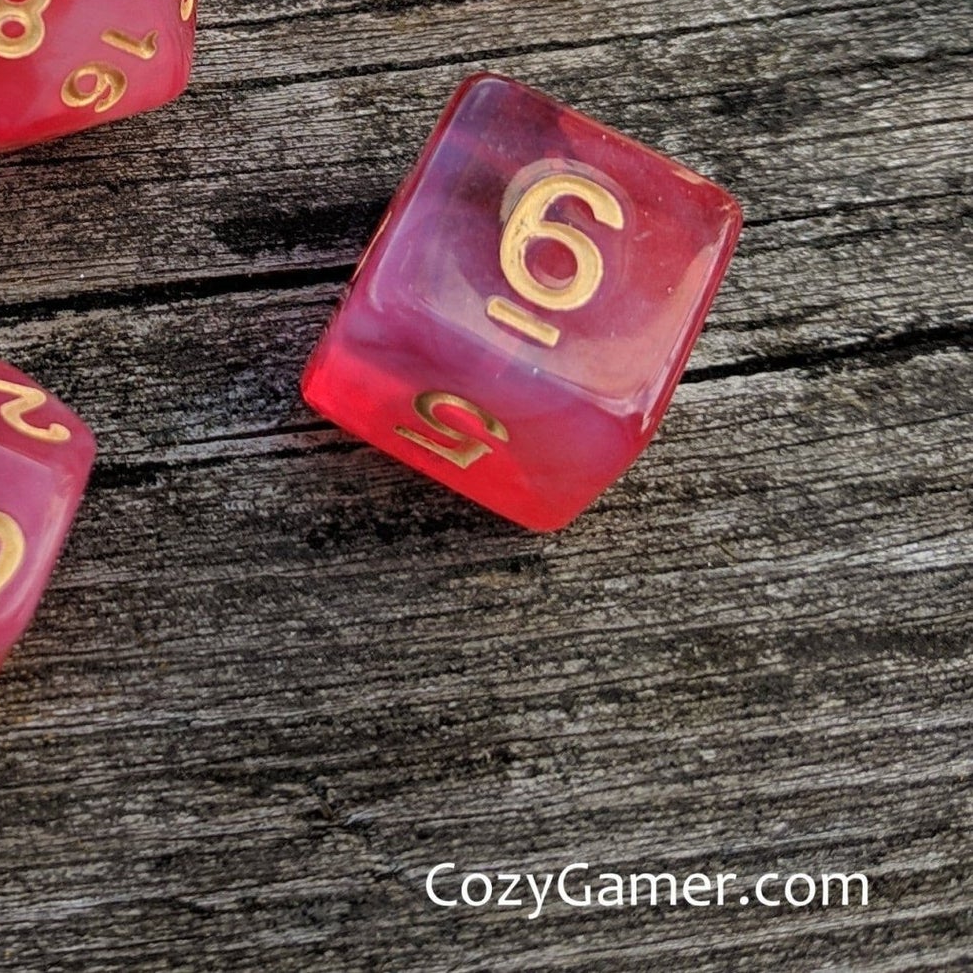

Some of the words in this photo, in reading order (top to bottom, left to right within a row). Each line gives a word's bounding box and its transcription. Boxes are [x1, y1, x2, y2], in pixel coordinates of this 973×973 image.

[61, 29, 159, 113] 16
[486, 174, 624, 348] 6
[394, 391, 509, 469] 5
